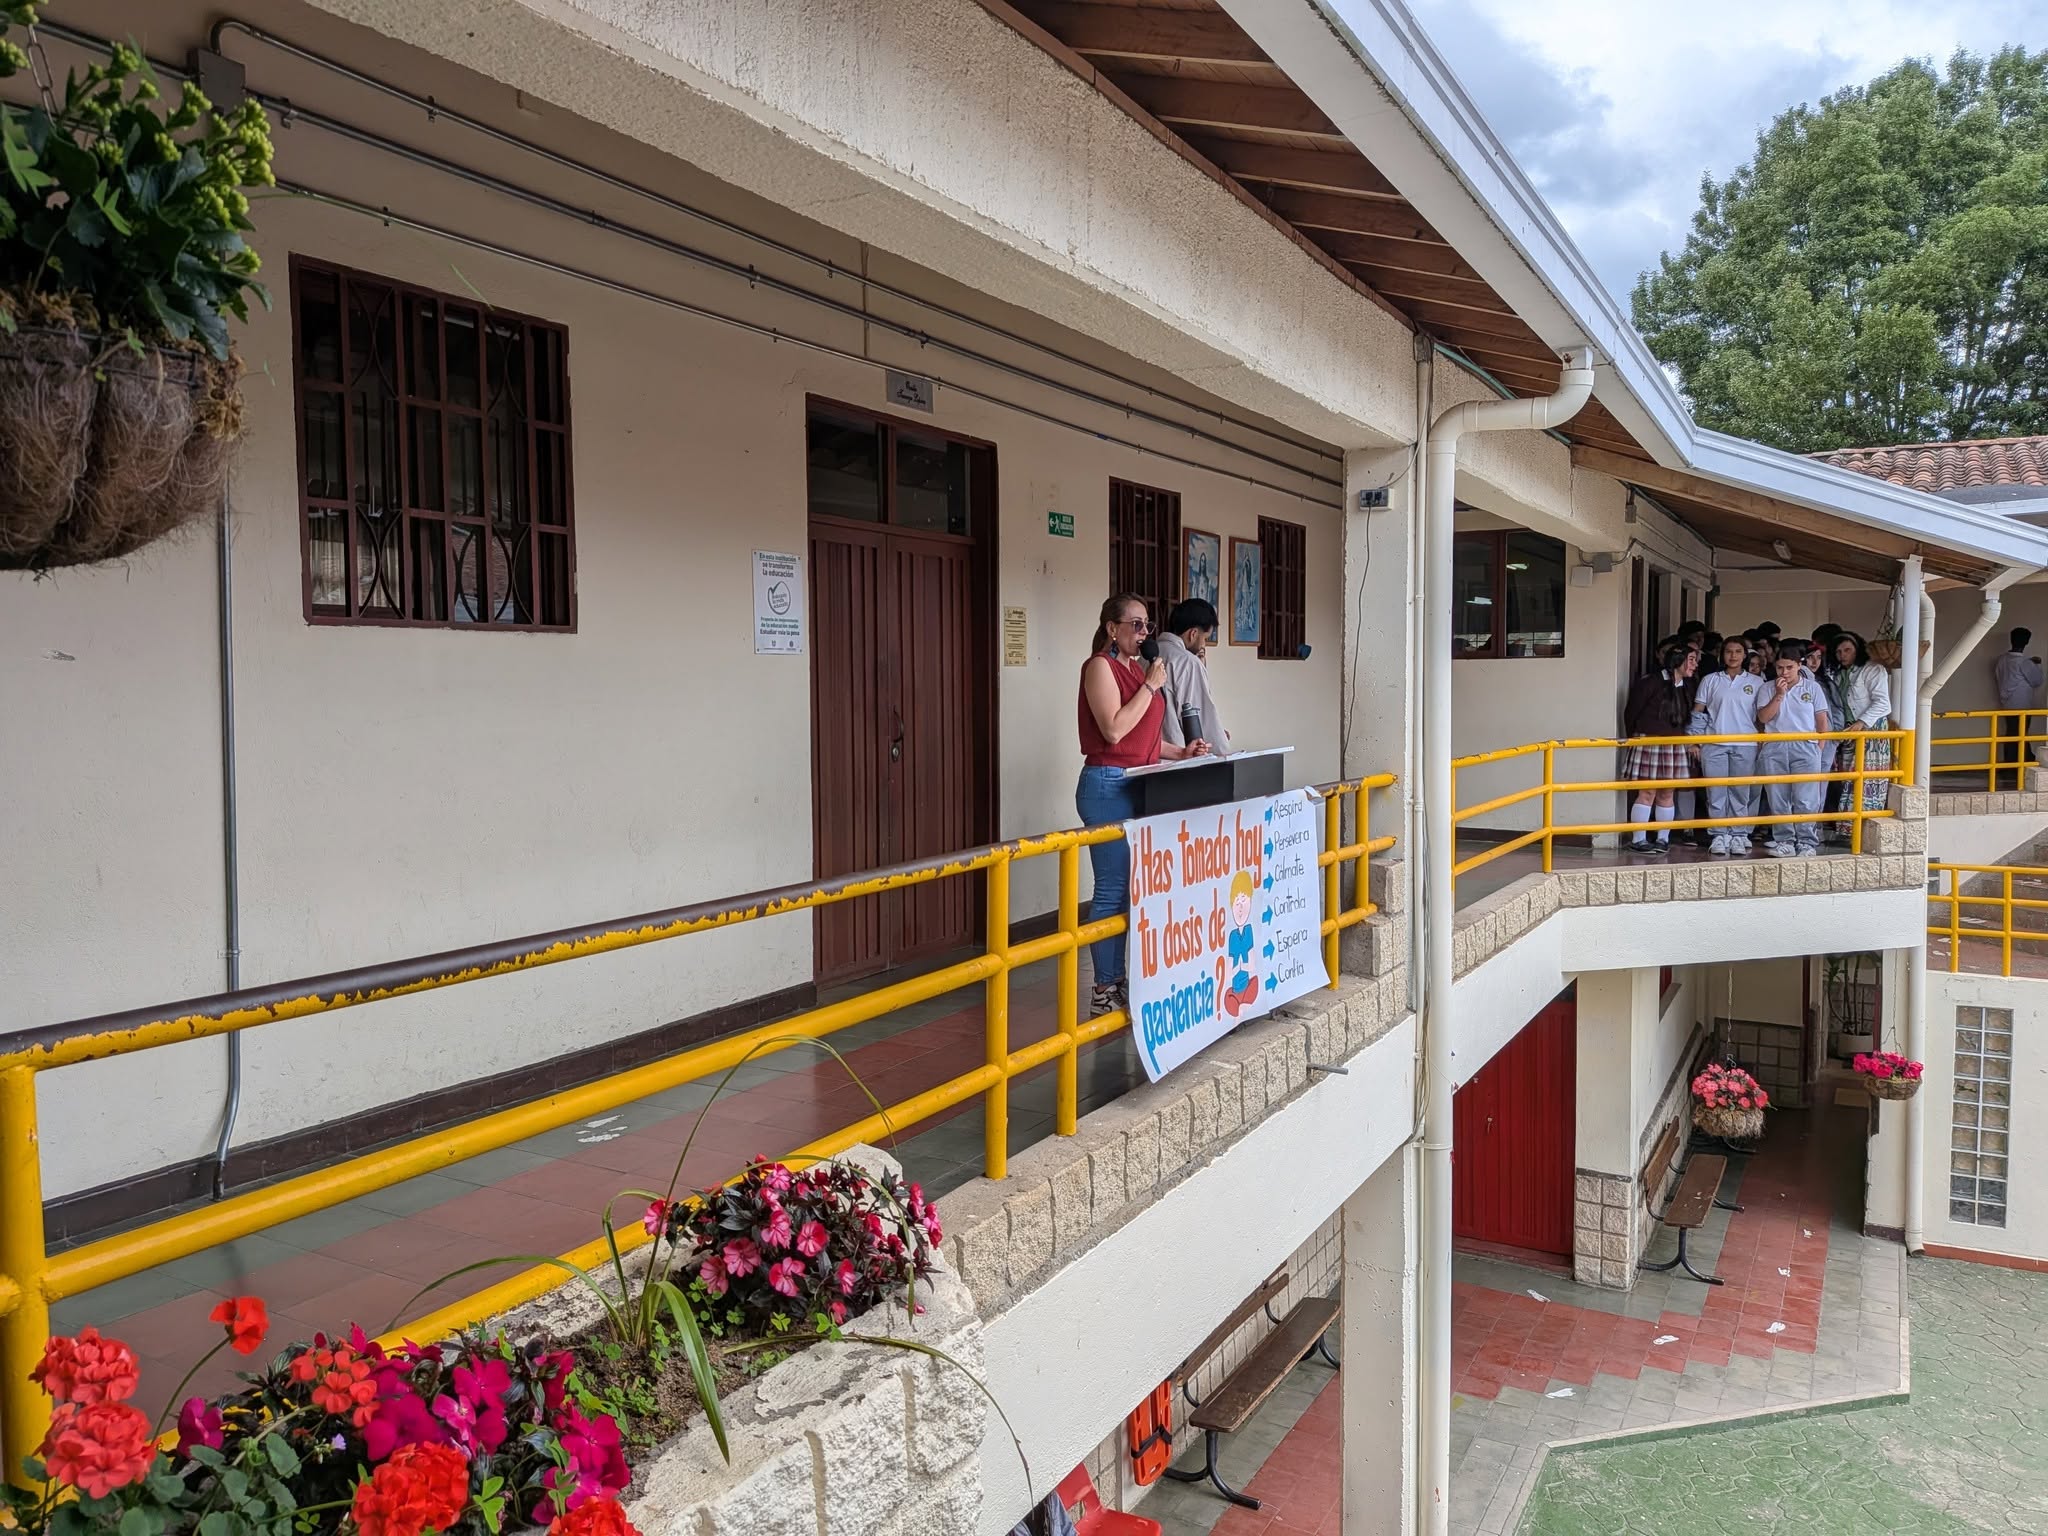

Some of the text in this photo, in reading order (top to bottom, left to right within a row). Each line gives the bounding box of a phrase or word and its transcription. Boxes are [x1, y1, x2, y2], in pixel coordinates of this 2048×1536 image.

[768, 562, 794, 570] transforma
[768, 569, 794, 578] educación
[1273, 799, 1303, 829] Respira
[1273, 830, 1310, 852] Persevera
[1131, 808, 1263, 907] ¿Has tomado hoy
[1273, 886, 1306, 918] Controla
[1137, 887, 1226, 979] tu dosis de
[1275, 929, 1308, 961] Espera
[1141, 955, 1226, 1075] paciencia?
